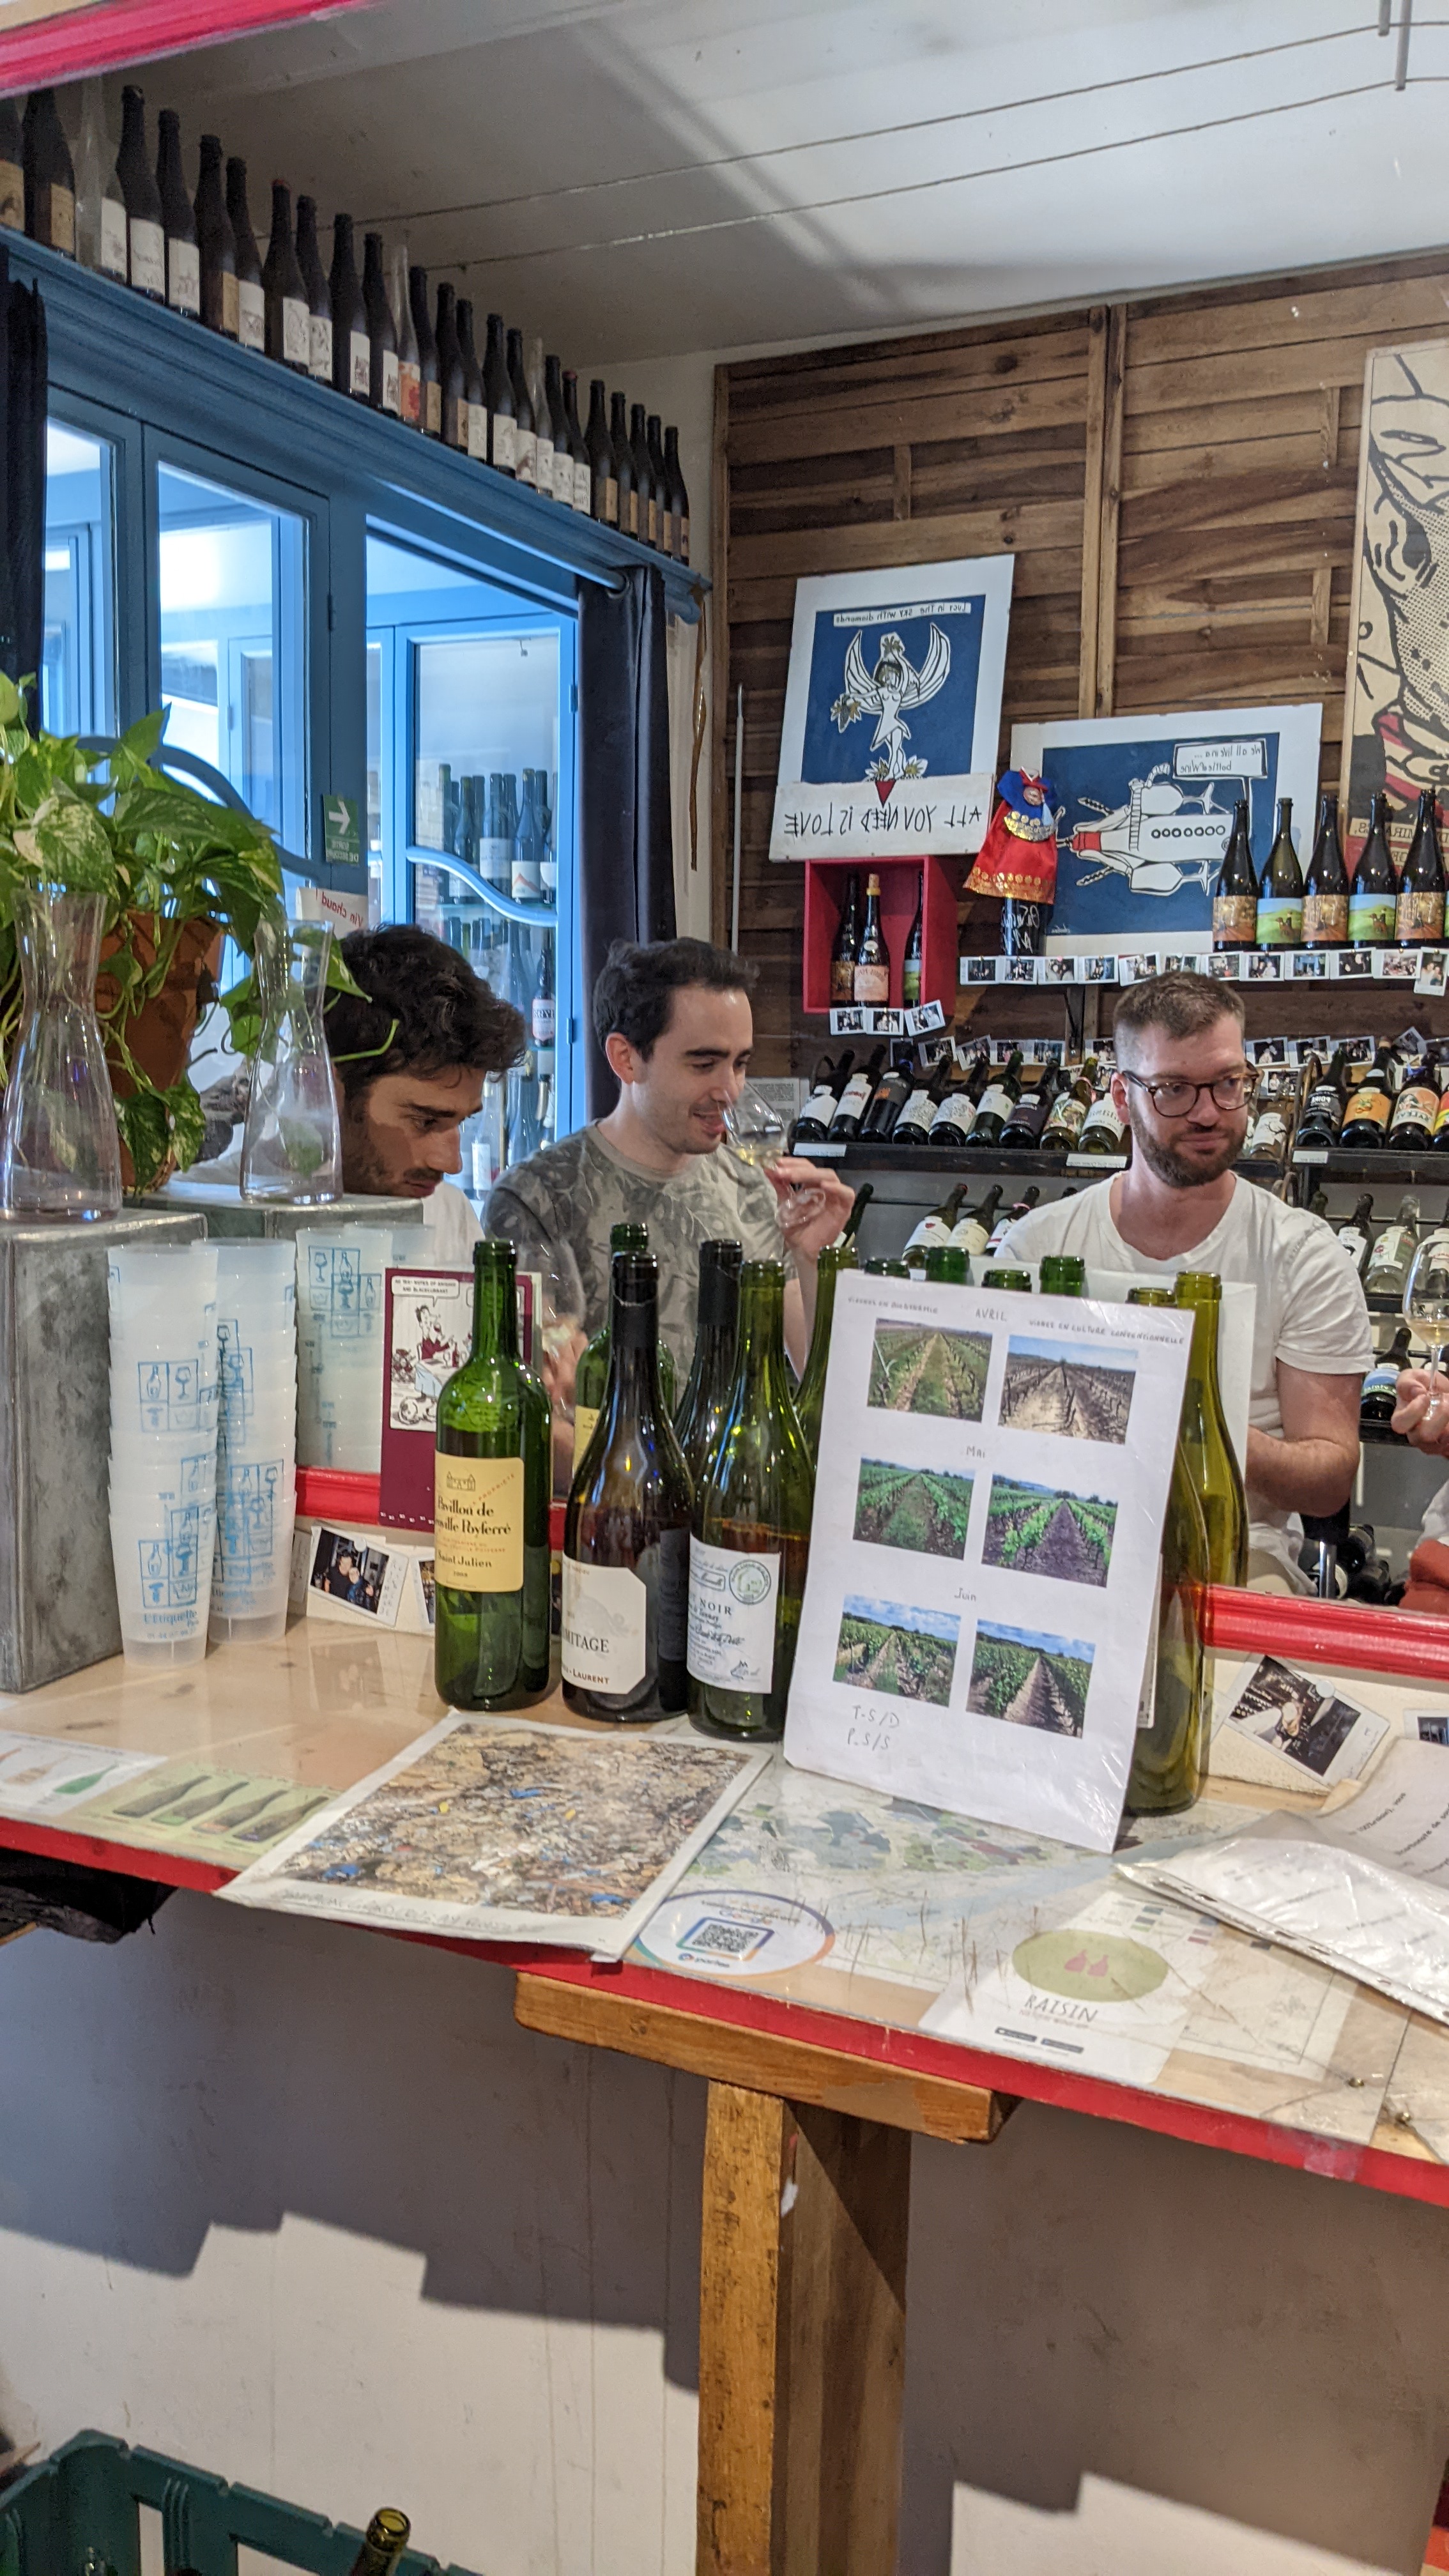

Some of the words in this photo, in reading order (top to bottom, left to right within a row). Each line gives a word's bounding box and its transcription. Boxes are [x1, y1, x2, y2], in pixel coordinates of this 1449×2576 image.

[975, 1308, 1007, 1322] AVRIL
[477, 1502, 494, 1517] de
[457, 1555, 492, 1568] Julien
[700, 1597, 732, 1616] NOIR
[562, 1629, 609, 1653] MITAGE
[1025, 1994, 1098, 2023] RAISIN
